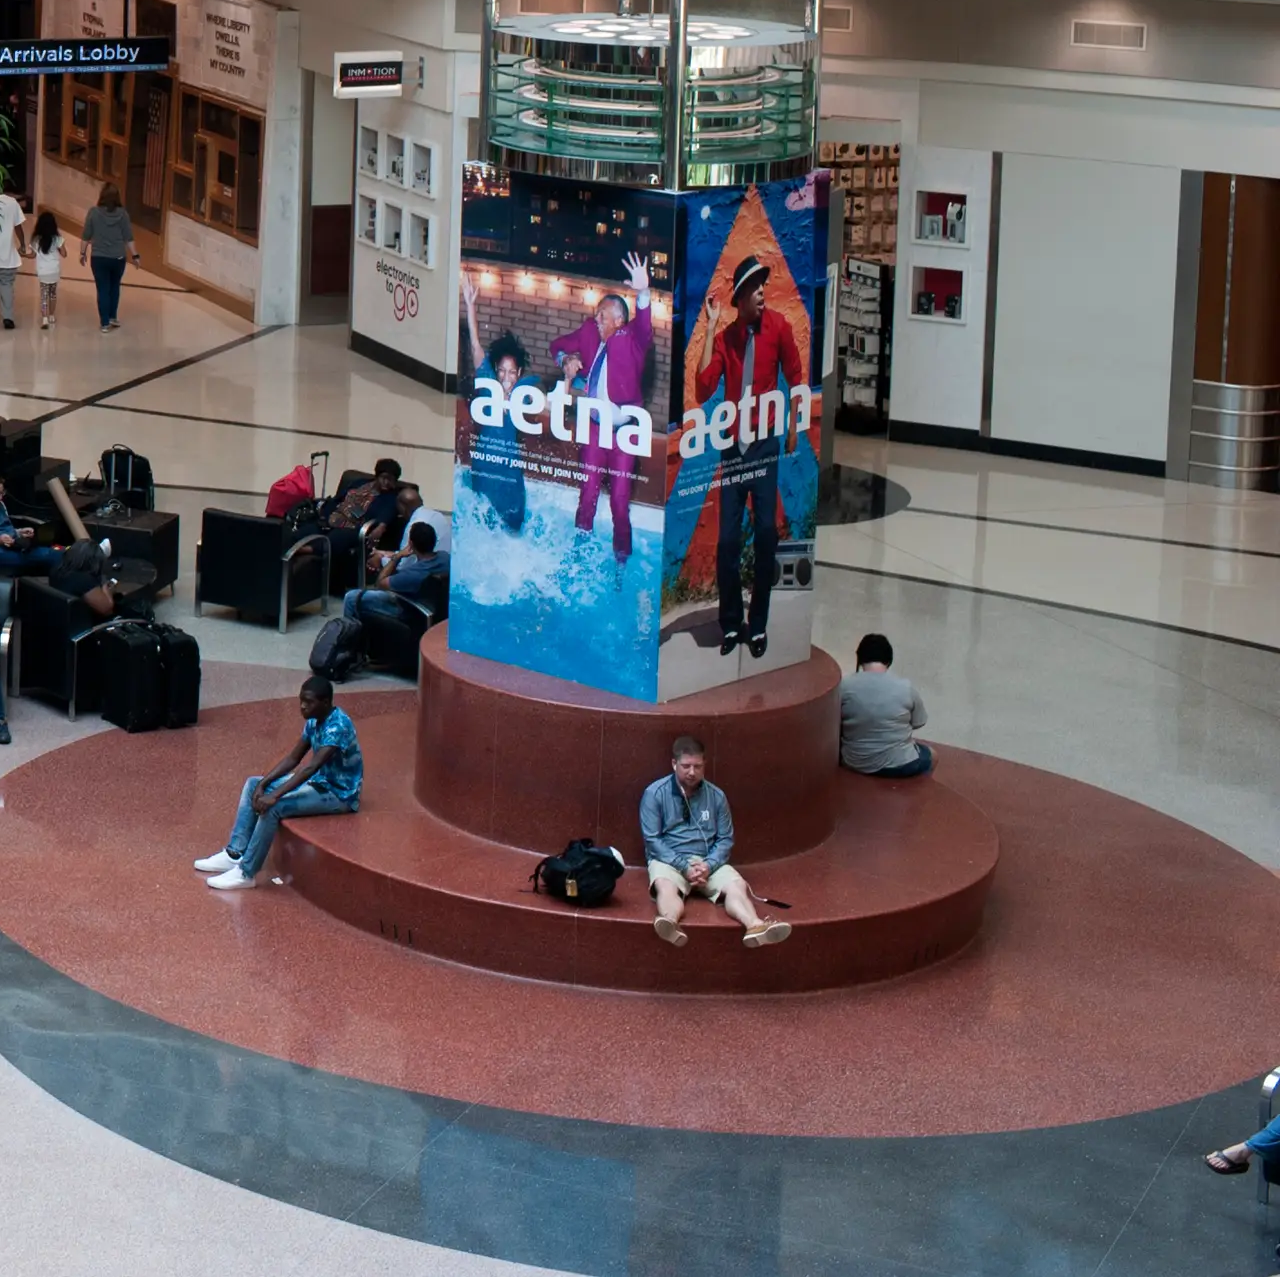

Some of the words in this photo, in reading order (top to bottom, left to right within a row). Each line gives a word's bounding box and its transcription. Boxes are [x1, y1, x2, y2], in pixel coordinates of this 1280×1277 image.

[82, 12, 105, 28] ETERNAL
[205, 12, 227, 28] WHERE
[227, 18, 251, 34] LIBERTY
[0, 45, 73, 63] Arrivals
[79, 43, 141, 63] Lobby
[209, 58, 218, 70] MY
[218, 61, 246, 78] COUNTRY
[215, 45, 234, 60] THERE
[234, 51, 240, 62] IS
[376, 258, 420, 290] electronics
[385, 278, 394, 293] to
[393, 283, 419, 322] go
[470, 377, 652, 458] aetna
[679, 384, 811, 459] aetna
[490, 438, 505, 447] young
[469, 450, 485, 460] YOU
[485, 453, 509, 465] DON'T
[509, 458, 527, 470] JOIN
[528, 462, 540, 473] US,
[540, 465, 553, 475] WE
[553, 468, 571, 479] JOIN
[572, 471, 589, 482] YOU
[486, 443, 508, 452] wellness
[528, 452, 543, 460] came
[567, 460, 578, 469] plan
[585, 462, 597, 471] help
[597, 465, 608, 474] you
[608, 467, 622, 477] keep
[626, 471, 637, 479] that
[678, 487, 689, 497] YOU
[690, 483, 708, 494] DON'T
[708, 479, 721, 492] JOIN
[741, 471, 754, 484] JOIN
[755, 467, 767, 478] YOU
